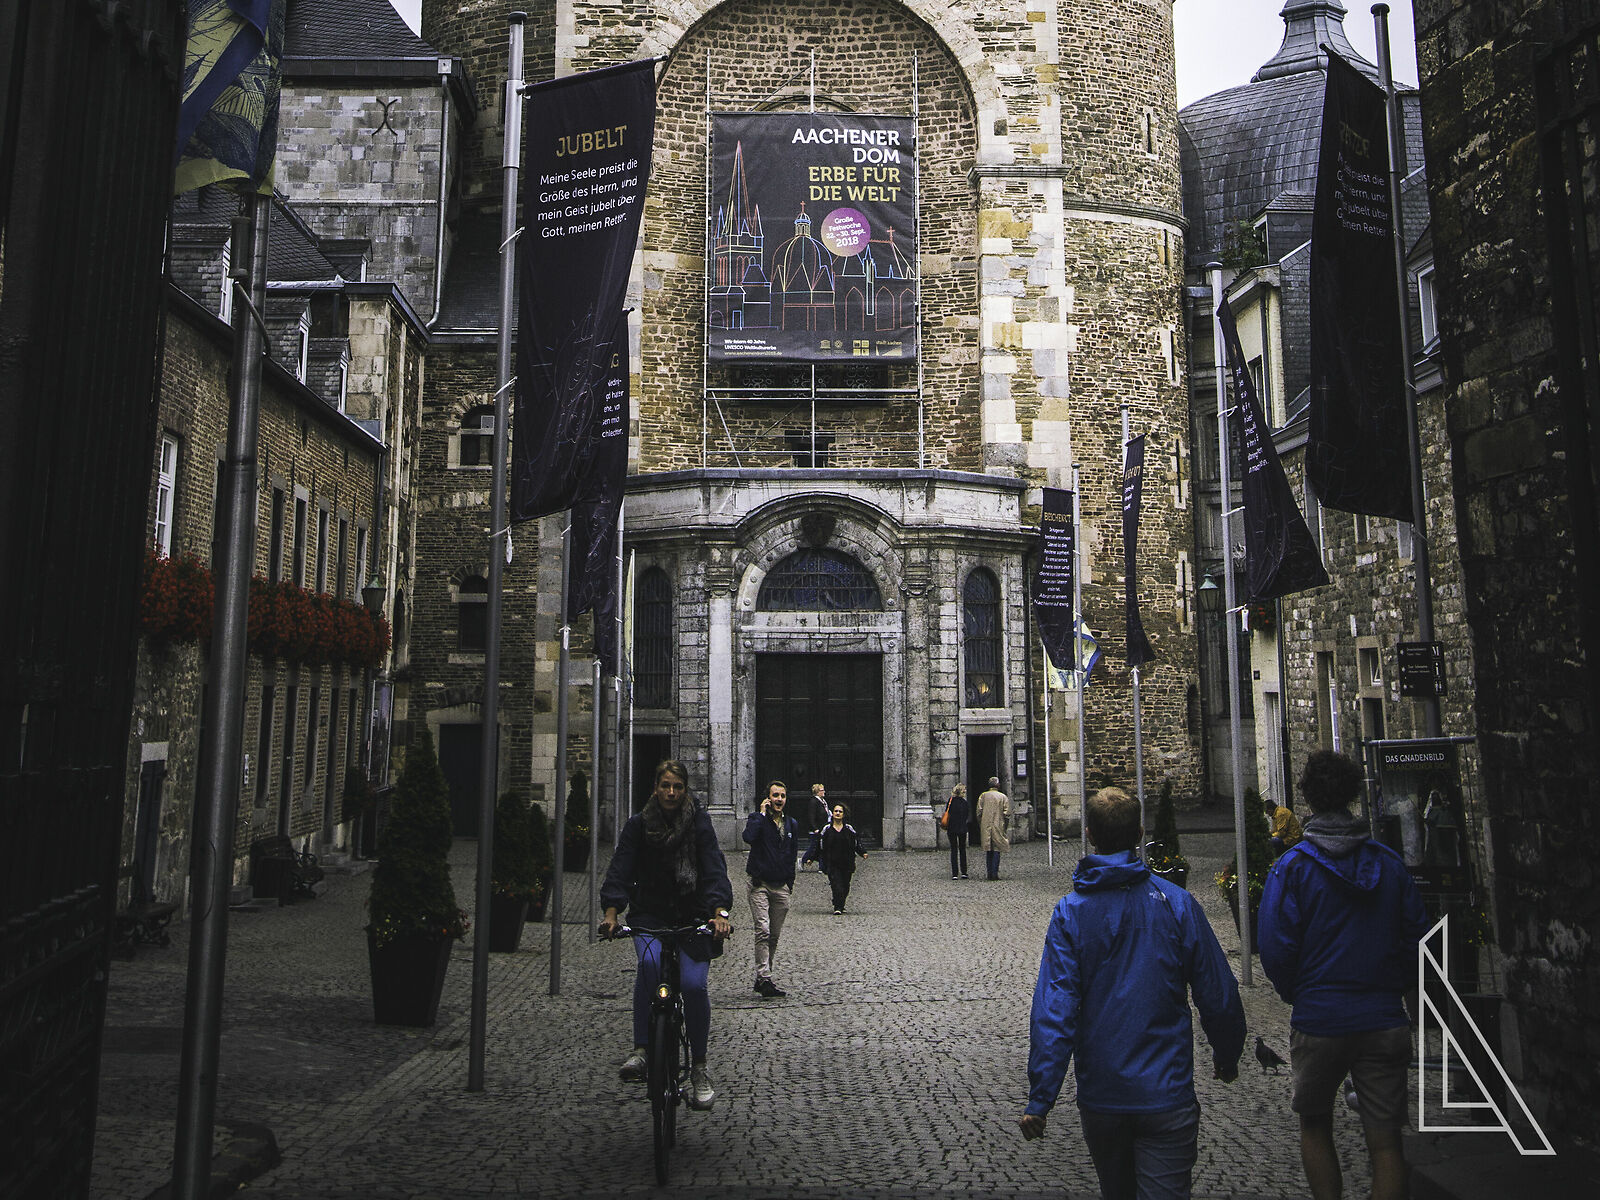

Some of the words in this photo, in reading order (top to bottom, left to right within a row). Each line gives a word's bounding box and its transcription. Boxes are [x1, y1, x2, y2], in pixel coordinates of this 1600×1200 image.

[556, 124, 627, 157] JUBELT
[791, 128, 901, 146] AACHENER
[852, 147, 901, 164] DOM
[540, 173, 570, 186] Meine
[571, 167, 597, 180] Seele
[599, 162, 625, 178] preist
[626, 158, 639, 170] die
[808, 166, 857, 182] ERBE
[862, 163, 901, 183] FÜR
[539, 189, 570, 203] Größe
[572, 187, 588, 198] des
[591, 184, 619, 195] Herrn,
[621, 176, 638, 188] und
[809, 185, 842, 201] DIE
[847, 185, 901, 202] WELT
[538, 208, 562, 220] mein
[564, 204, 588, 217] Geist
[590, 198, 616, 216] jubelt
[541, 227, 566, 239] Gott,
[568, 220, 602, 234] meinen
[836, 236, 859, 247] 2018
[1385, 754, 1399, 763] DAS
[1399, 753, 1445, 763] GNADENBILD
